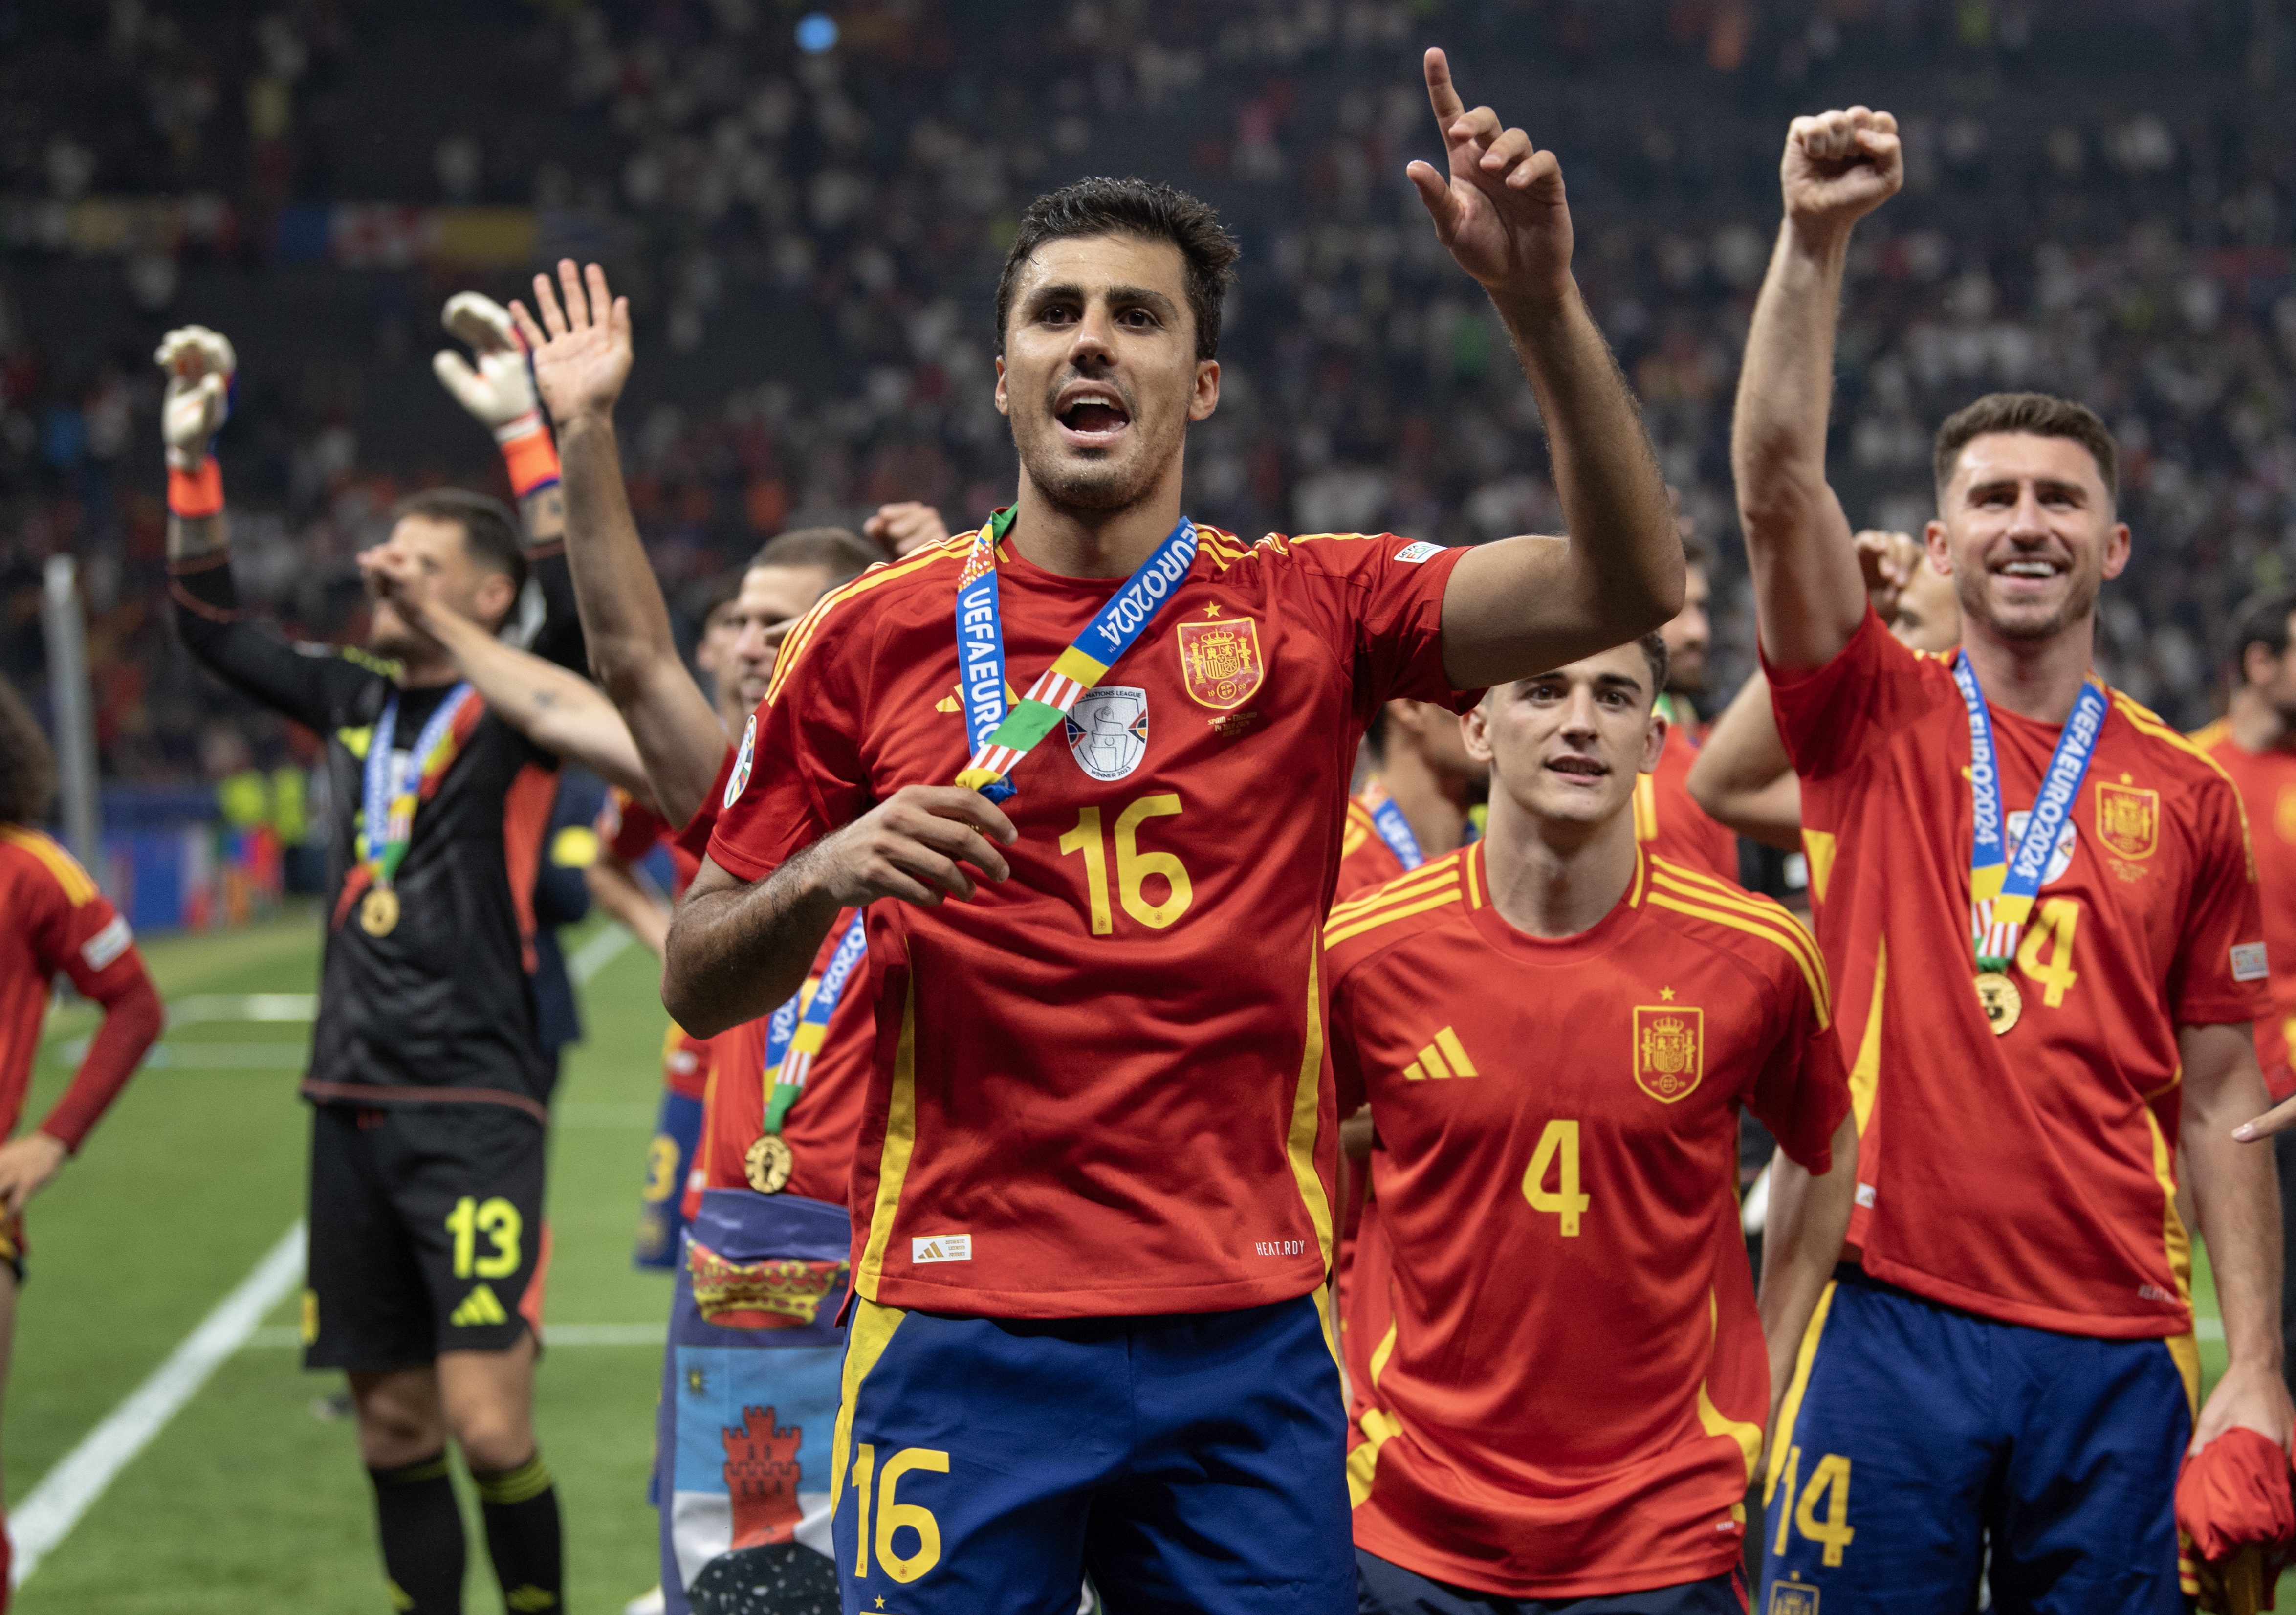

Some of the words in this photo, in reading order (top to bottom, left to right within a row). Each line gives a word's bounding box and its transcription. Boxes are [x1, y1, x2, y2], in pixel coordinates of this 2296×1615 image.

[1091, 769, 1116, 778] WINNER
[1117, 766, 1132, 776] 2023
[1059, 793, 1193, 935] 16
[444, 1195, 523, 1279] 13
[1521, 1118, 1590, 1238] 4
[1255, 1240, 1305, 1256] HEAT.RDY
[852, 1443, 950, 1584] 16
[1772, 1446, 1856, 1567] 14
